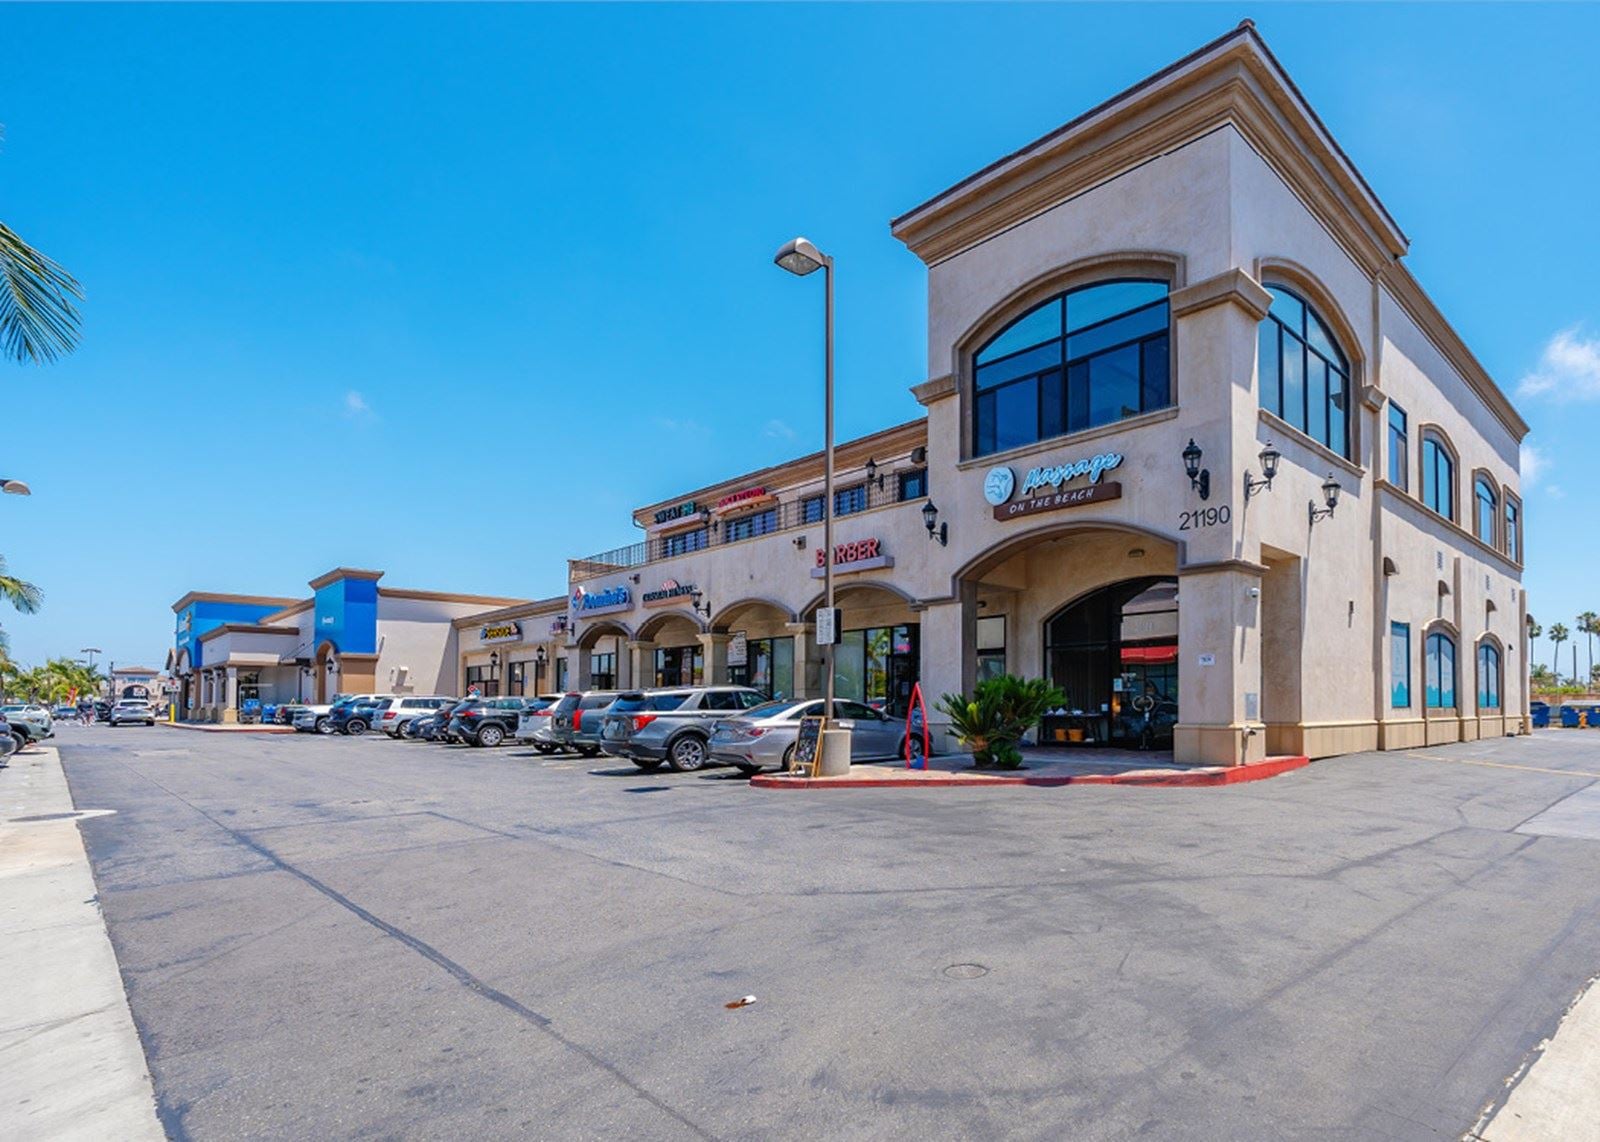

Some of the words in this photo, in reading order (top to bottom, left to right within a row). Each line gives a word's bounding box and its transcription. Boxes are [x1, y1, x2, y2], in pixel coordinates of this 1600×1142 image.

[1022, 453, 1124, 494] Massage
[1009, 502, 1025, 515] ON
[1030, 497, 1050, 510] THE
[1055, 488, 1095, 506] BEACH
[1178, 505, 1231, 531] 21190
[815, 538, 879, 568] BRBER
